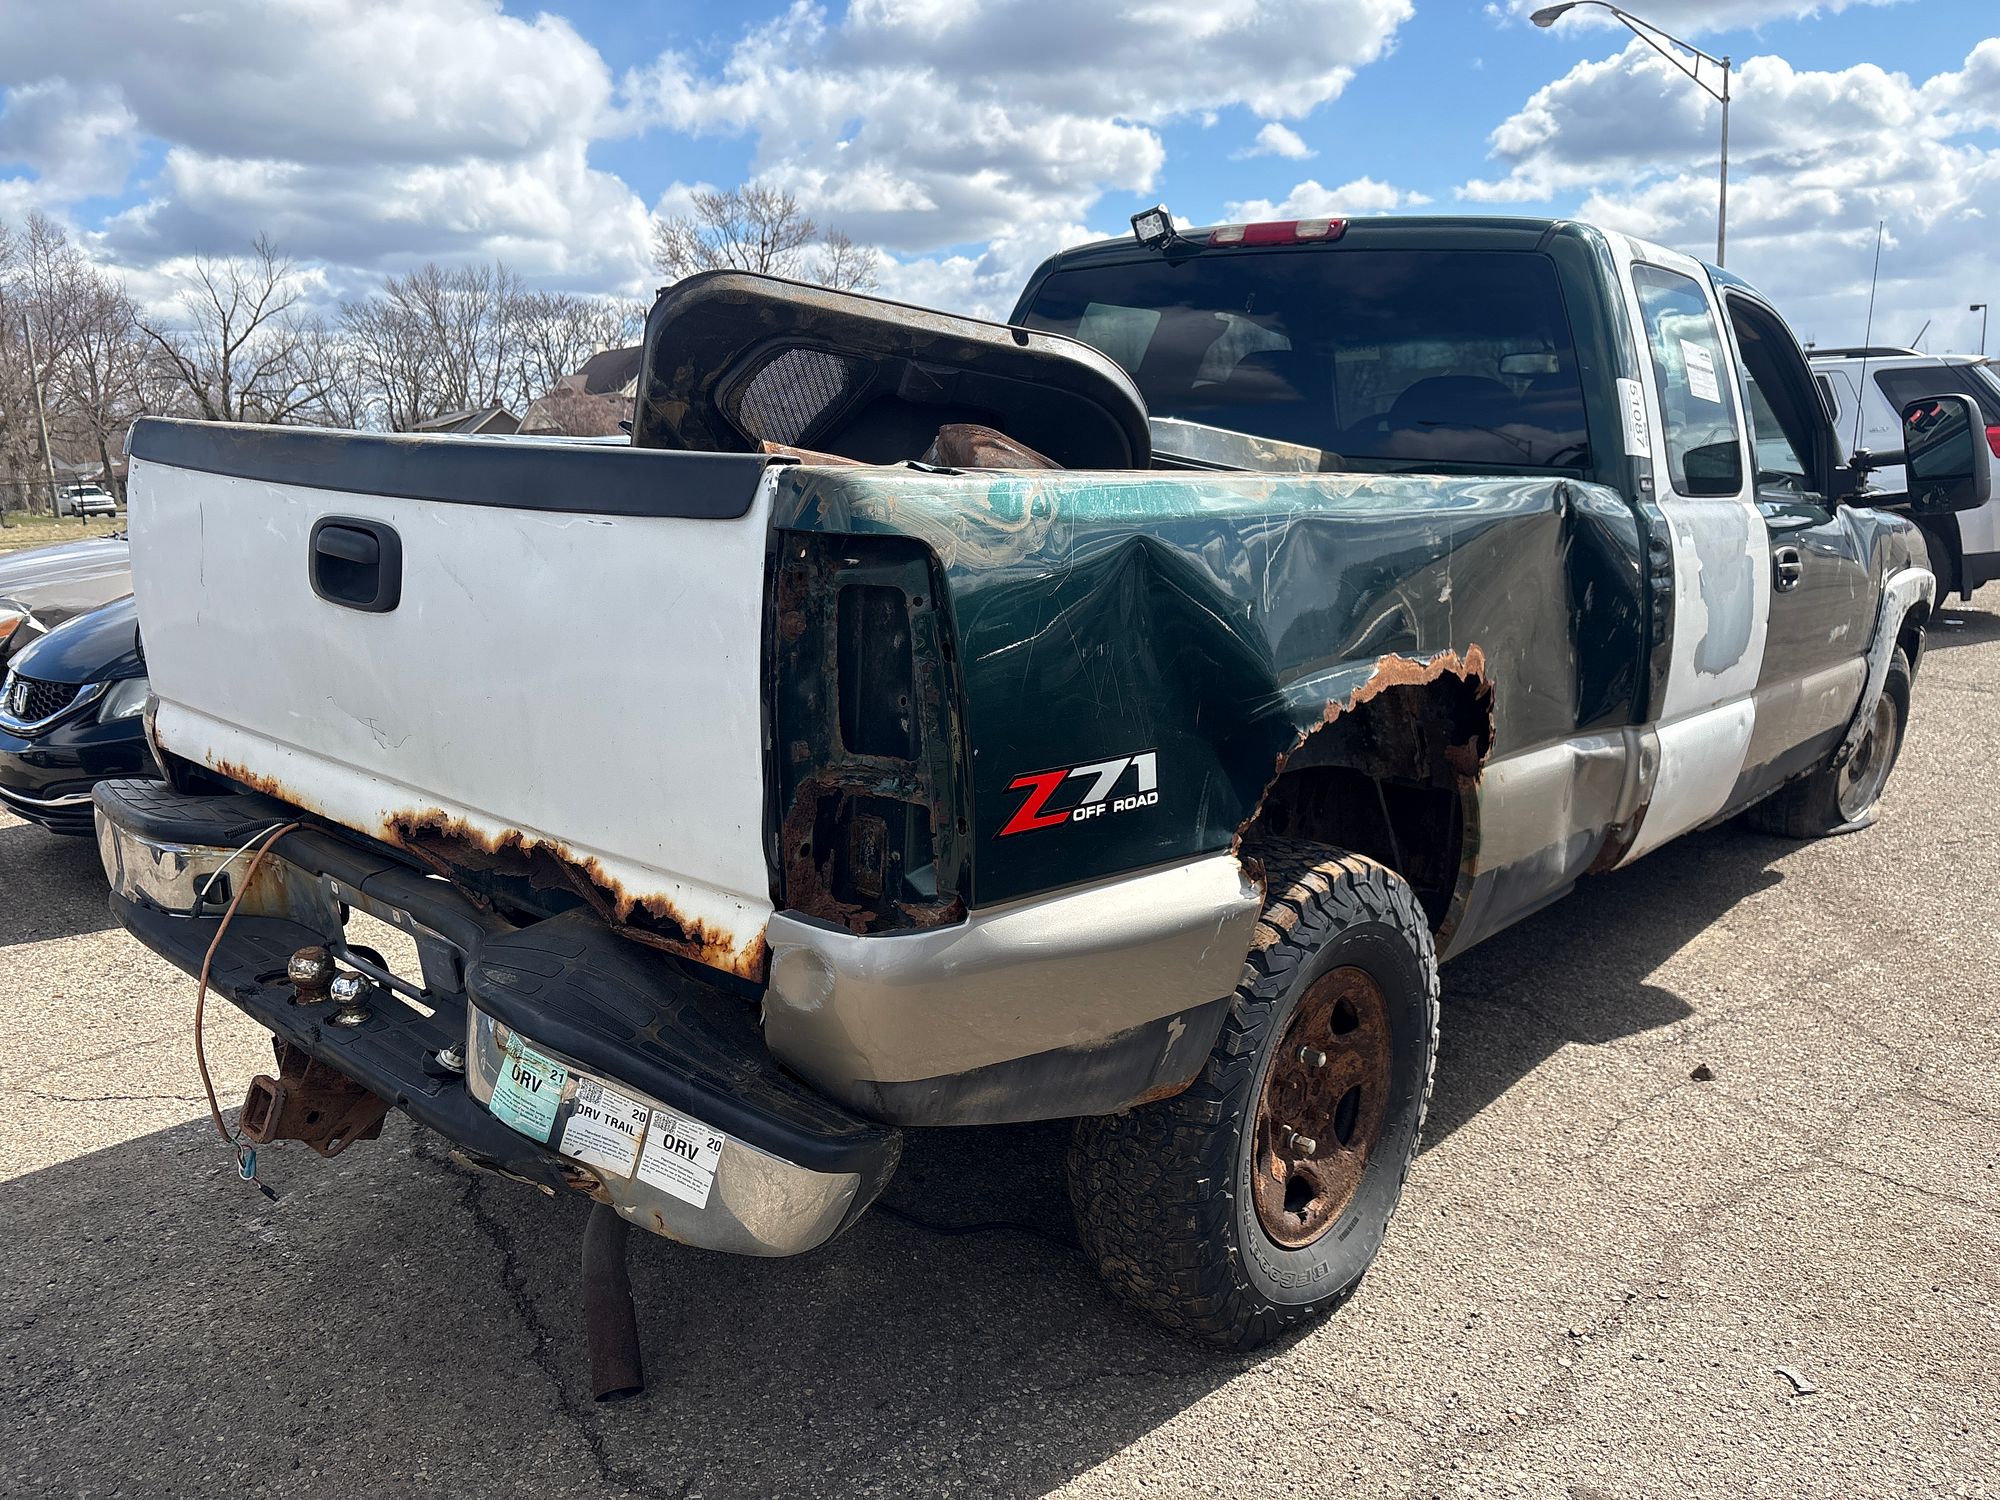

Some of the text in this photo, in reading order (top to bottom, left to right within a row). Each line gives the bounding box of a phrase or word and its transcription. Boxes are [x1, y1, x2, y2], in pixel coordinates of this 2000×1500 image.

[1629, 383, 1645, 448] 51087
[999, 751, 1157, 837] Z71
[1072, 791, 1159, 822] OFF ROAD
[511, 1063, 543, 1093] ORV
[549, 1069, 564, 1084] 21
[604, 1113, 636, 1137] TRAIL
[631, 1108, 647, 1123] 20
[663, 1133, 699, 1161] ORV
[706, 1137, 722, 1152] 20
